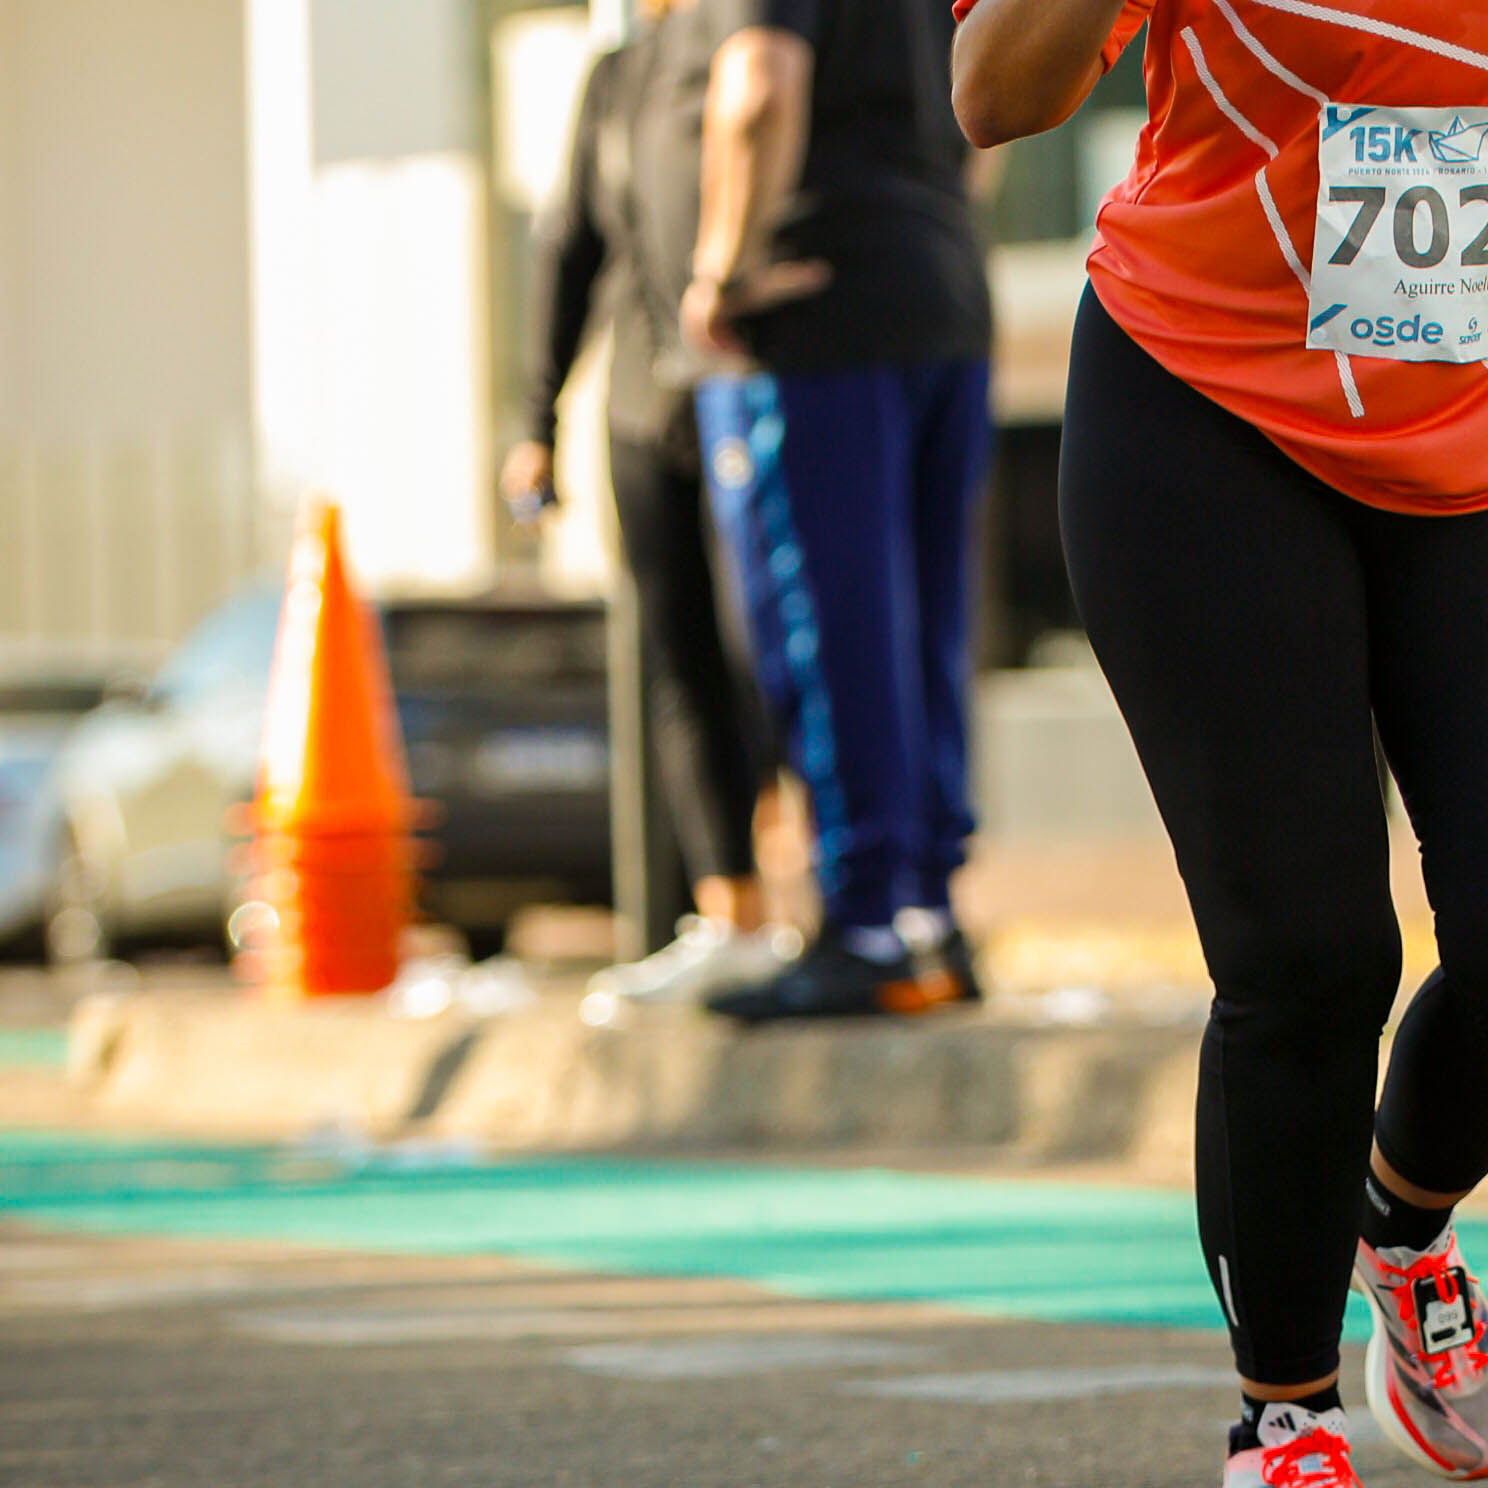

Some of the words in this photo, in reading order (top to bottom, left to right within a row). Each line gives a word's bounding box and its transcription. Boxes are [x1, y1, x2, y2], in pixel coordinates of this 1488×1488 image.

[1350, 126, 1422, 162] 15K
[1348, 167, 1382, 176] PUERTO
[1438, 167, 1476, 175] ROSARIO
[1393, 279, 1455, 298] Aguirre
[1350, 313, 1444, 347] osde
